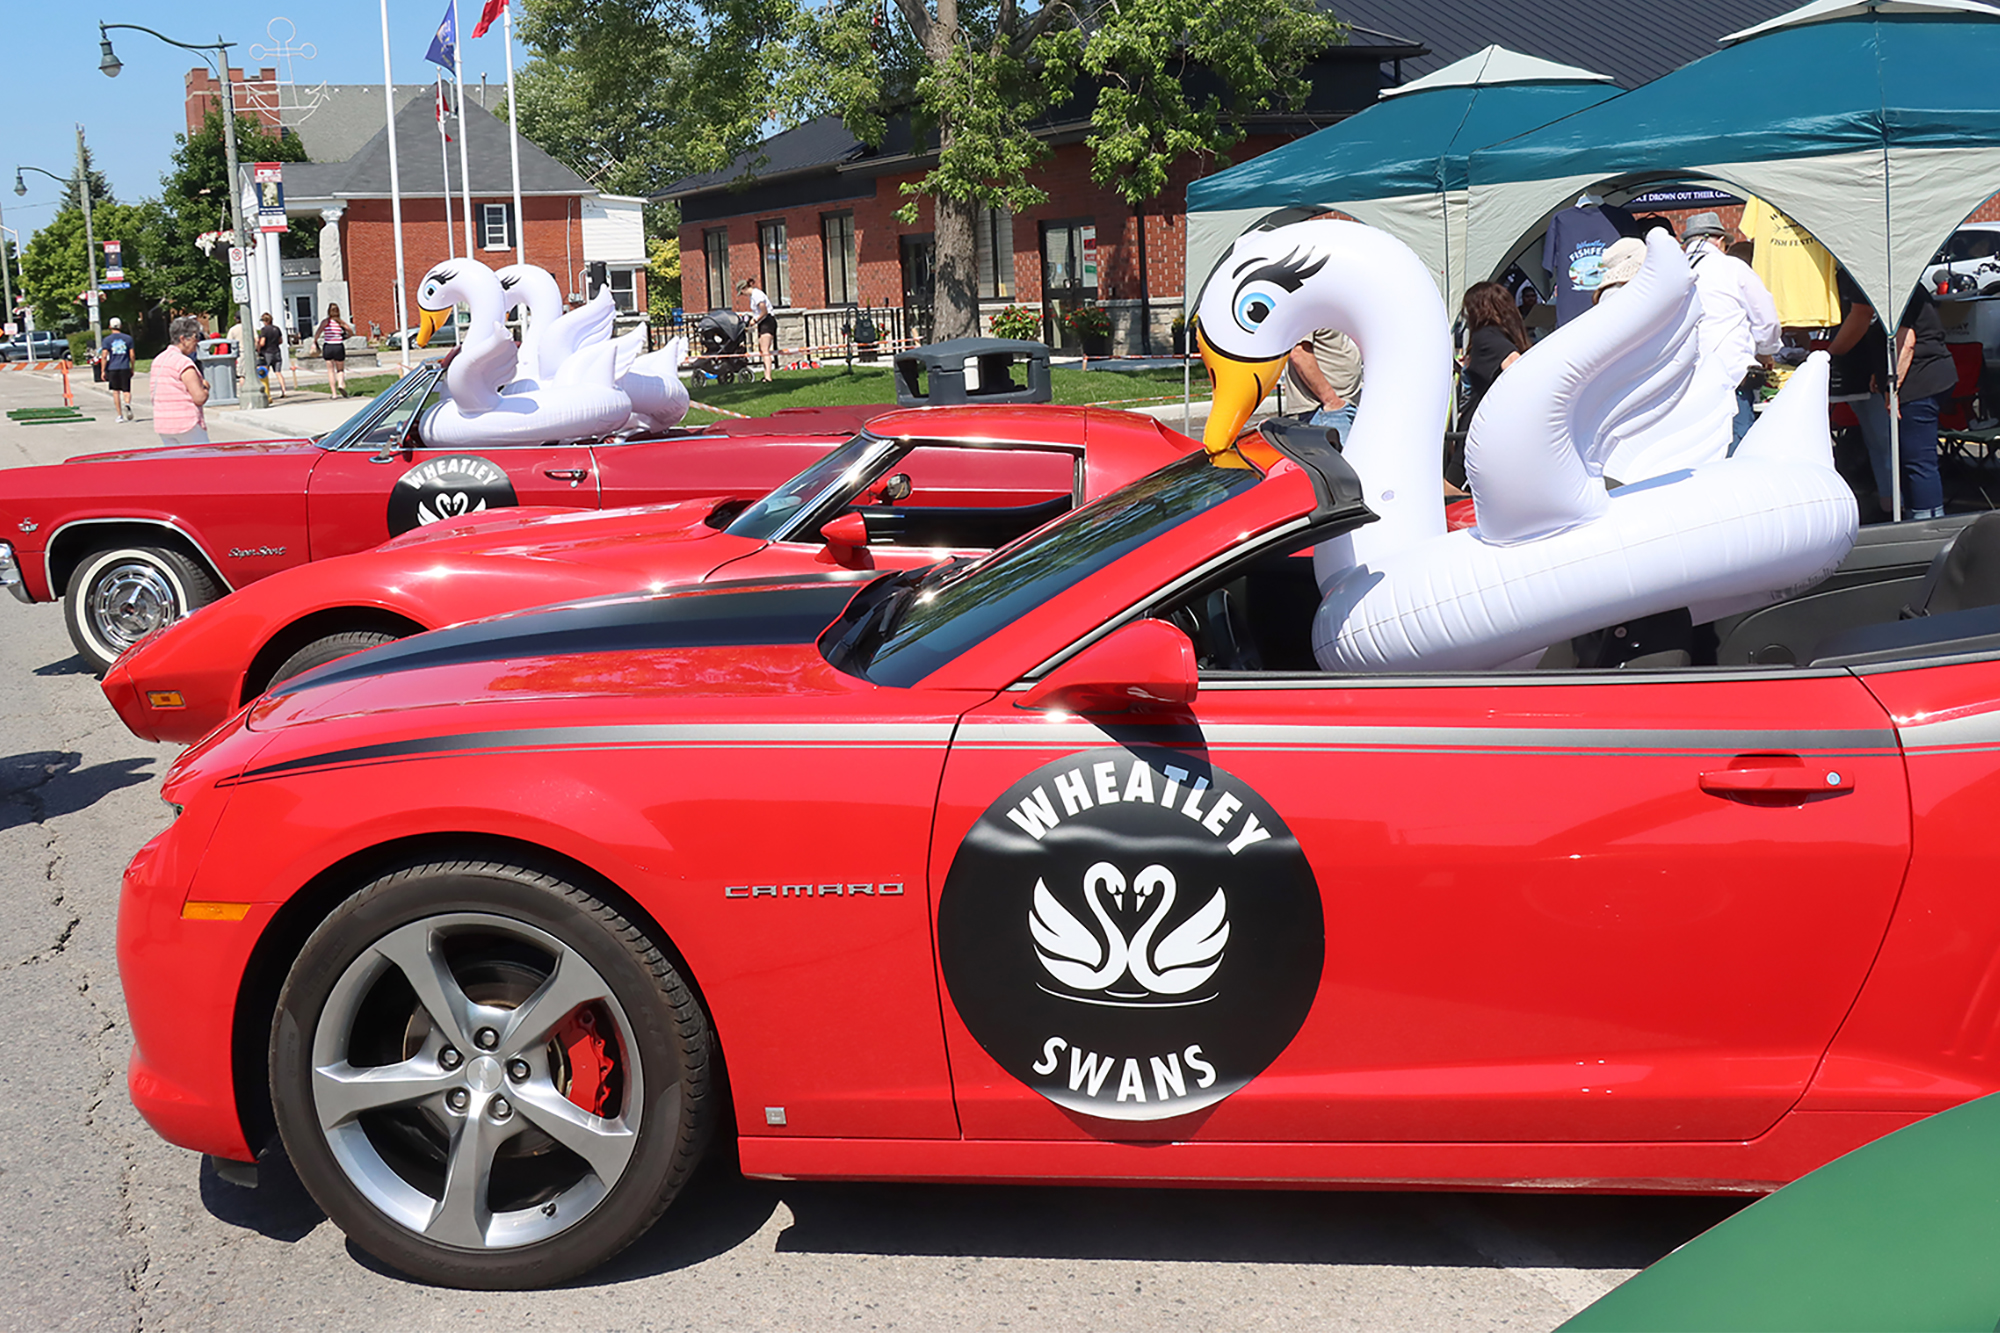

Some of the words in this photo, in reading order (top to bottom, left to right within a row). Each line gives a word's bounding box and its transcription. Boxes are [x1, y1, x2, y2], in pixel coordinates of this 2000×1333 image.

[1648, 192, 1676, 202] DROWN
[1676, 191, 1692, 201] OUT
[1693, 190, 1715, 199] THEIR
[1770, 237, 1788, 247] FISH
[405, 458, 499, 490] WHEATLEY
[228, 547, 257, 560] Super
[258, 545, 287, 557] Sport
[1006, 761, 1272, 856] WHEATLEY
[725, 883, 904, 898] CAMARO
[1032, 1036, 1217, 1103] SWANS
